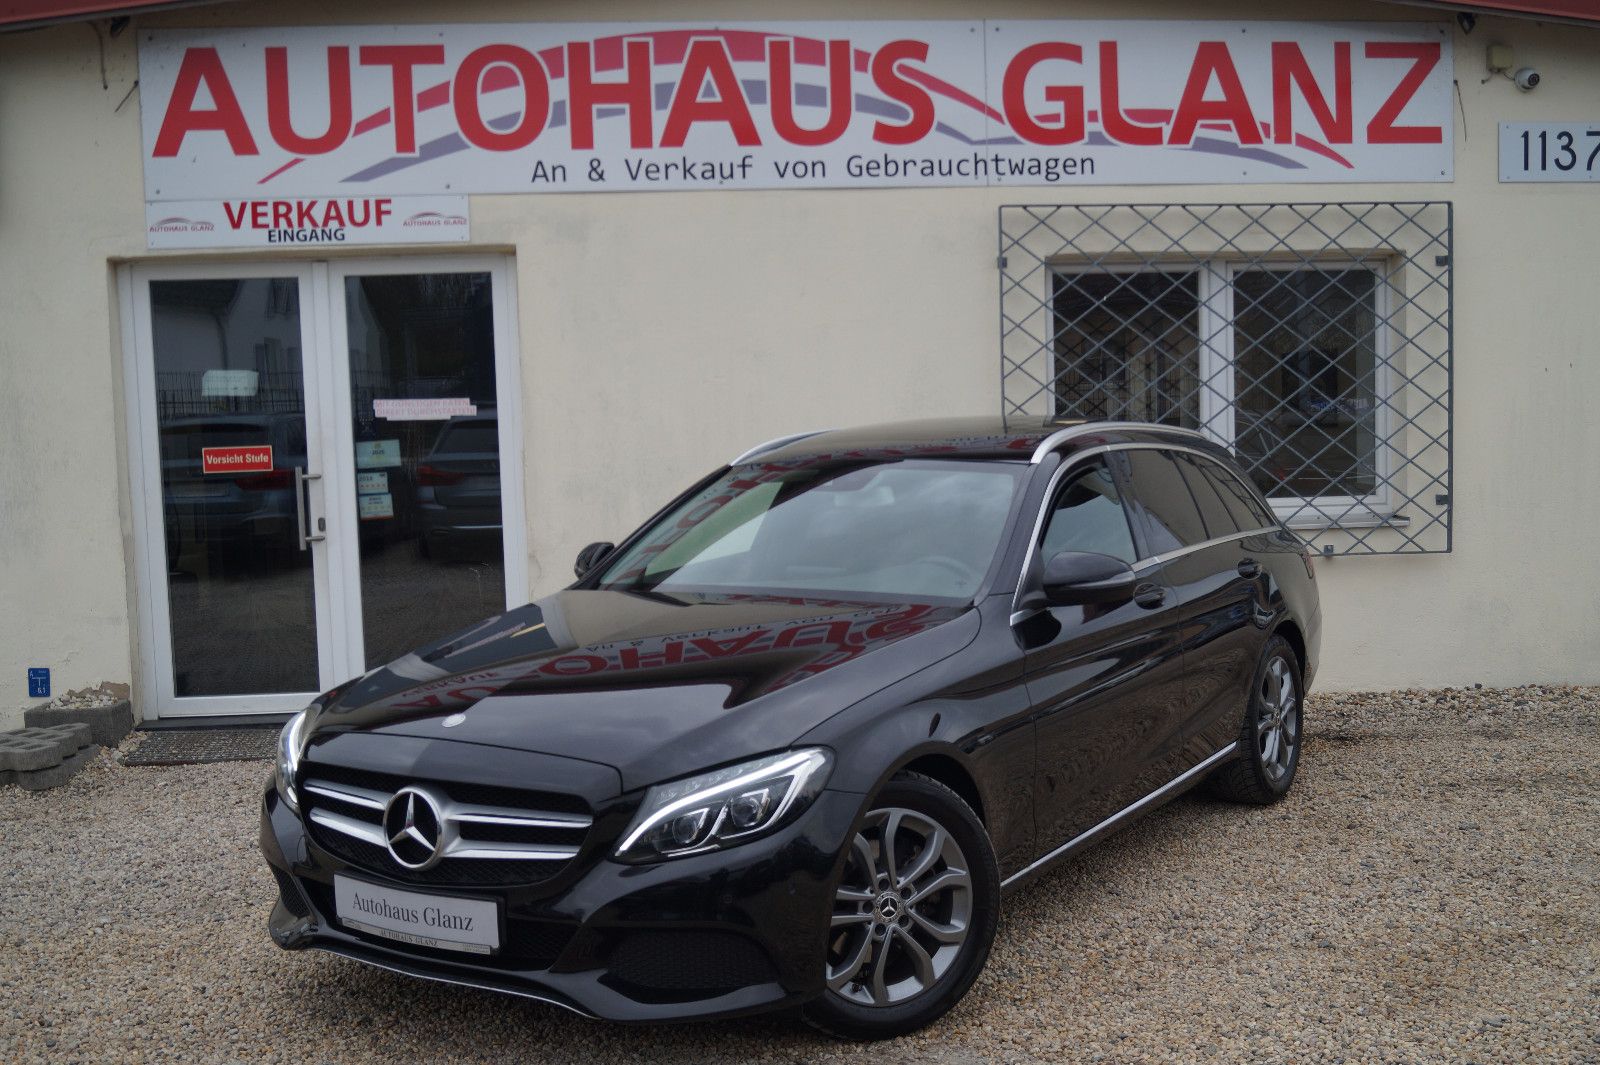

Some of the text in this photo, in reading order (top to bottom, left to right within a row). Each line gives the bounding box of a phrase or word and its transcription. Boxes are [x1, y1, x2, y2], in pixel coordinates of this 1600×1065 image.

[152, 38, 1443, 158] AUTOHAUS GLANZ
[1520, 130, 1600, 171] 1137
[531, 153, 1096, 183] An & Verkauf von Gebrauchtwagen
[223, 198, 392, 230] VERKAUF
[403, 218, 467, 227] AUTOHAUS GLANZ
[149, 224, 215, 233] AUTOHAUS GLANZ
[268, 228, 346, 243] EINGANG
[206, 452, 269, 465] Vorsicht Stufe
[352, 892, 474, 932] Autohaus Glanz
[379, 929, 439, 947] AUTOHAUS GLANZ
